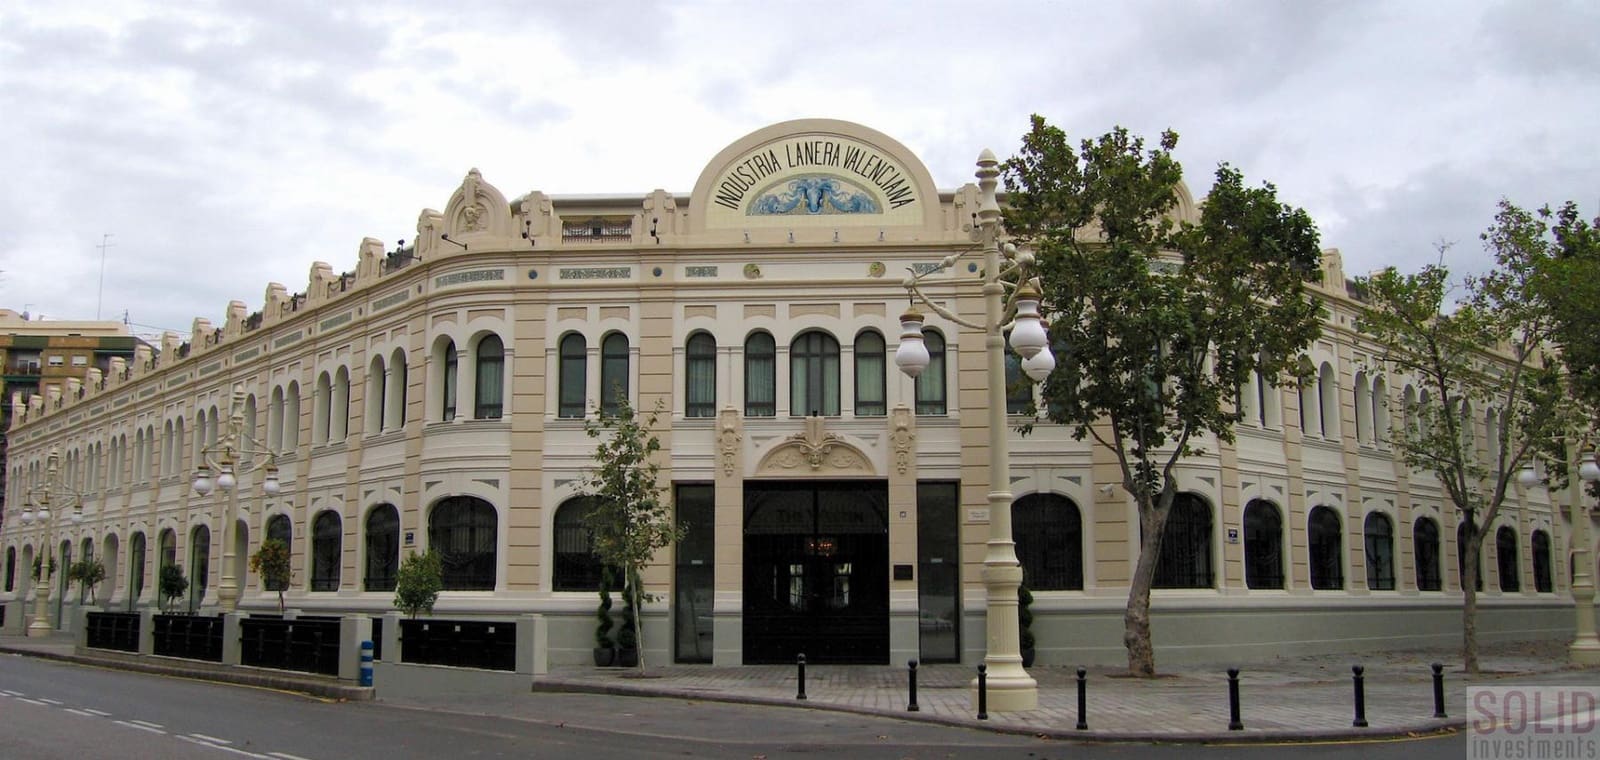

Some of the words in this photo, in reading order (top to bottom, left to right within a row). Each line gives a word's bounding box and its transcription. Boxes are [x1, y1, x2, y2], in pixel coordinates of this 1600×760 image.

[714, 149, 782, 210] INDUSTRIA
[785, 141, 840, 168] LANERA
[844, 145, 916, 210] VALENCIANA
